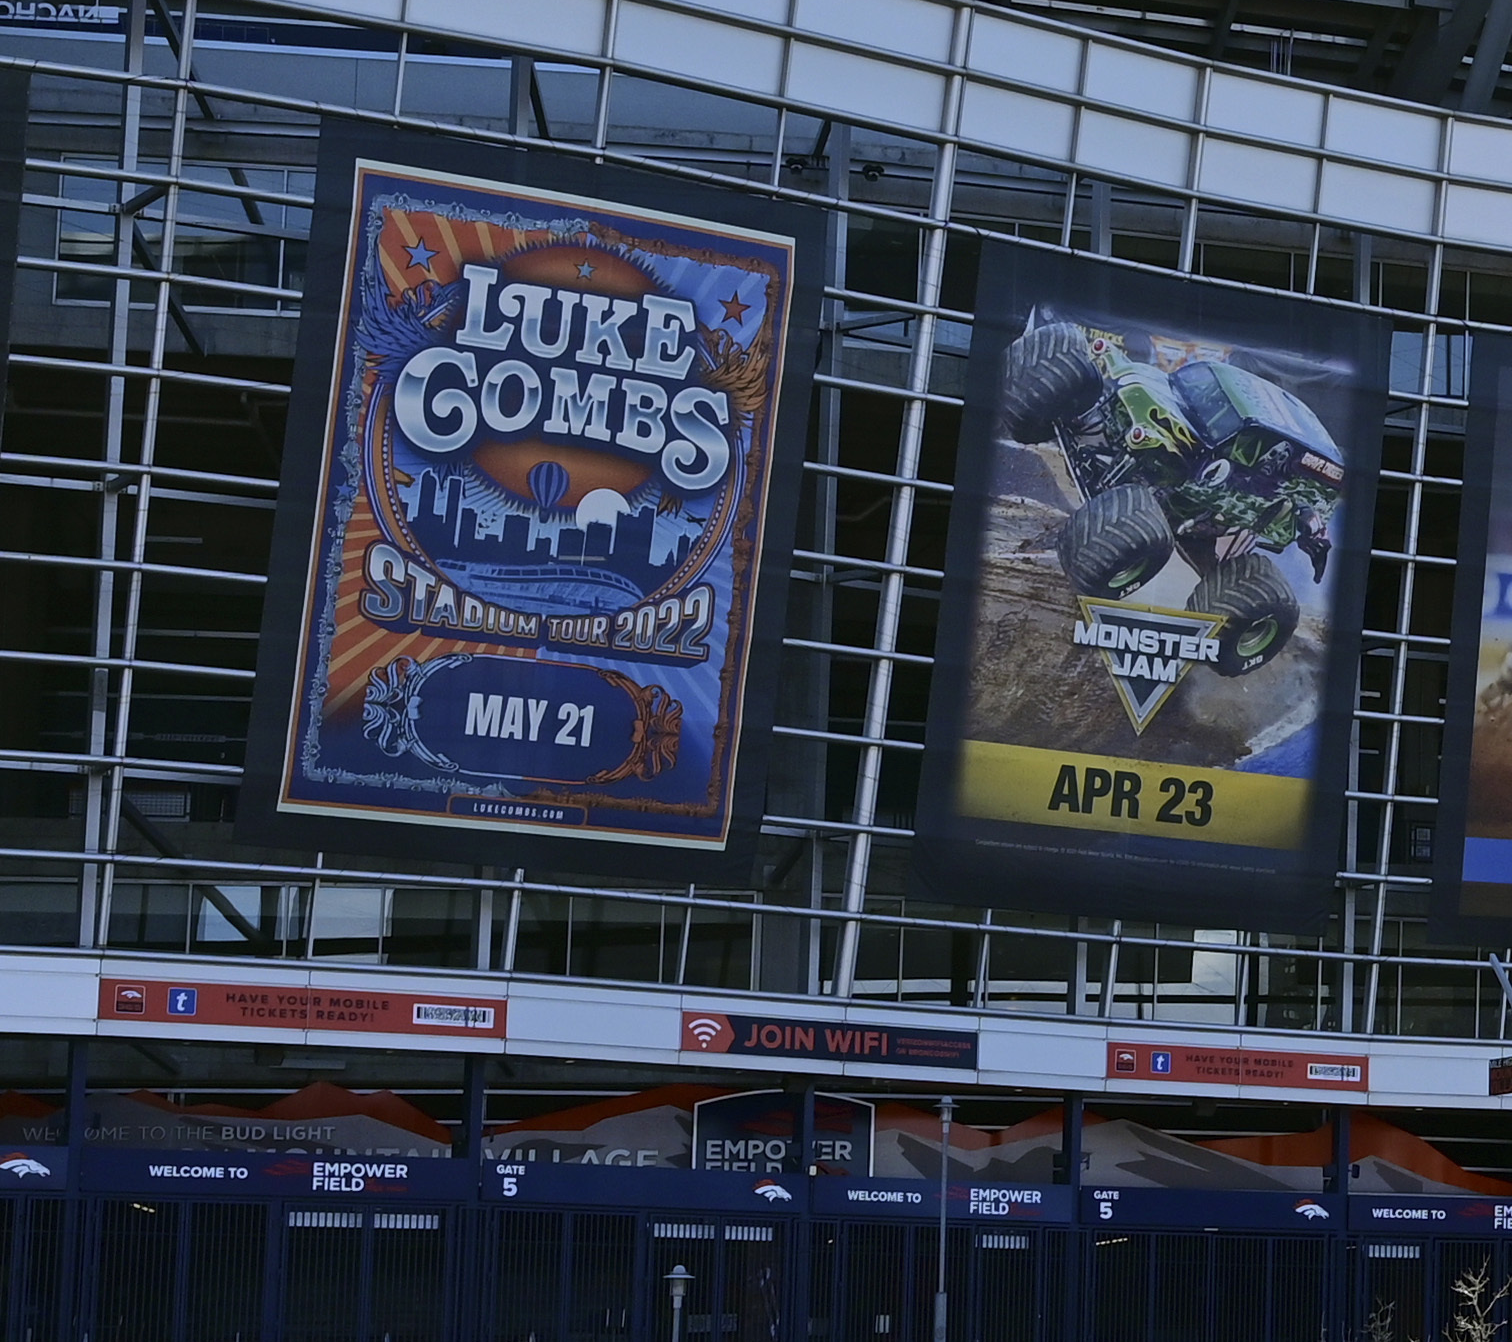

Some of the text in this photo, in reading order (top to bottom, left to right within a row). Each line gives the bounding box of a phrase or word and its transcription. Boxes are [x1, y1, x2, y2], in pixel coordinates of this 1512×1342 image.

[455, 265, 697, 381] LUKE
[395, 348, 730, 489] COMBS
[362, 543, 712, 657] STADIUM TOUR 2022
[1073, 620, 1220, 662] MONSTER
[1112, 653, 1177, 682] JAM
[465, 693, 595, 747] MAY 21
[1048, 765, 1213, 827] APR 23
[473, 802, 564, 821] LUKECOMBS.COM
[226, 992, 390, 1011] HAVE YOUR MOBILE
[240, 1006, 375, 1023] TICKETS READY!
[744, 1024, 889, 1056] JOIN WIFI
[1186, 1054, 1293, 1068] HAVE YOUR MOBILE
[1195, 1066, 1284, 1079] TICKETS READY!
[137, 1126, 335, 1140] TO THE BUD LIGHT
[706, 1139, 852, 1161] EMPOER
[149, 1164, 248, 1179] WELCOME TO
[312, 1162, 408, 1178] EMPOWER
[496, 1164, 525, 1175] GATE
[312, 1177, 365, 1191] FIELD
[502, 1177, 517, 1197] 5
[847, 1190, 921, 1203] WELCOME TO
[970, 1188, 1041, 1204] EMPOWER
[1094, 1190, 1119, 1200] GATE
[970, 1202, 1009, 1215] FIELD
[1100, 1202, 1113, 1219] 5
[1372, 1208, 1446, 1220] WELCOME TO
